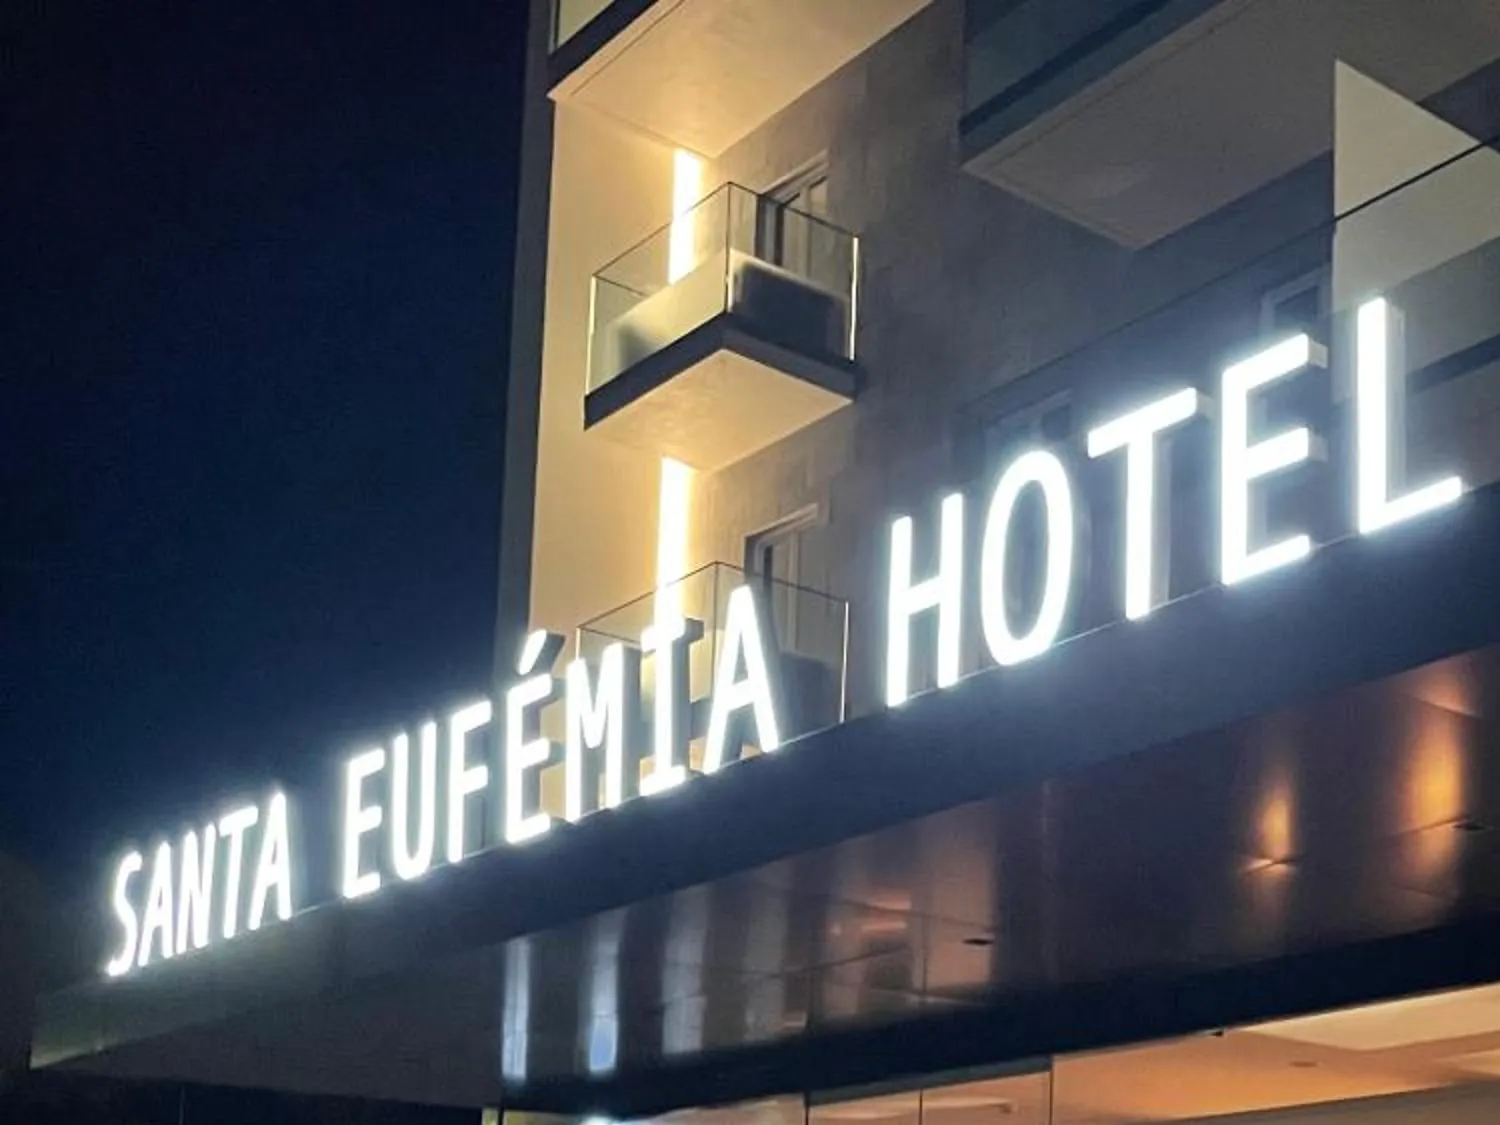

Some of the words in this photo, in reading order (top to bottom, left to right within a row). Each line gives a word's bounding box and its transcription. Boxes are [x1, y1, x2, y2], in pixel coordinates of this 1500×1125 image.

[105, 790, 293, 977] SANTA
[341, 584, 780, 899] EUFÉMIA
[886, 296, 1464, 708] HOTEL
